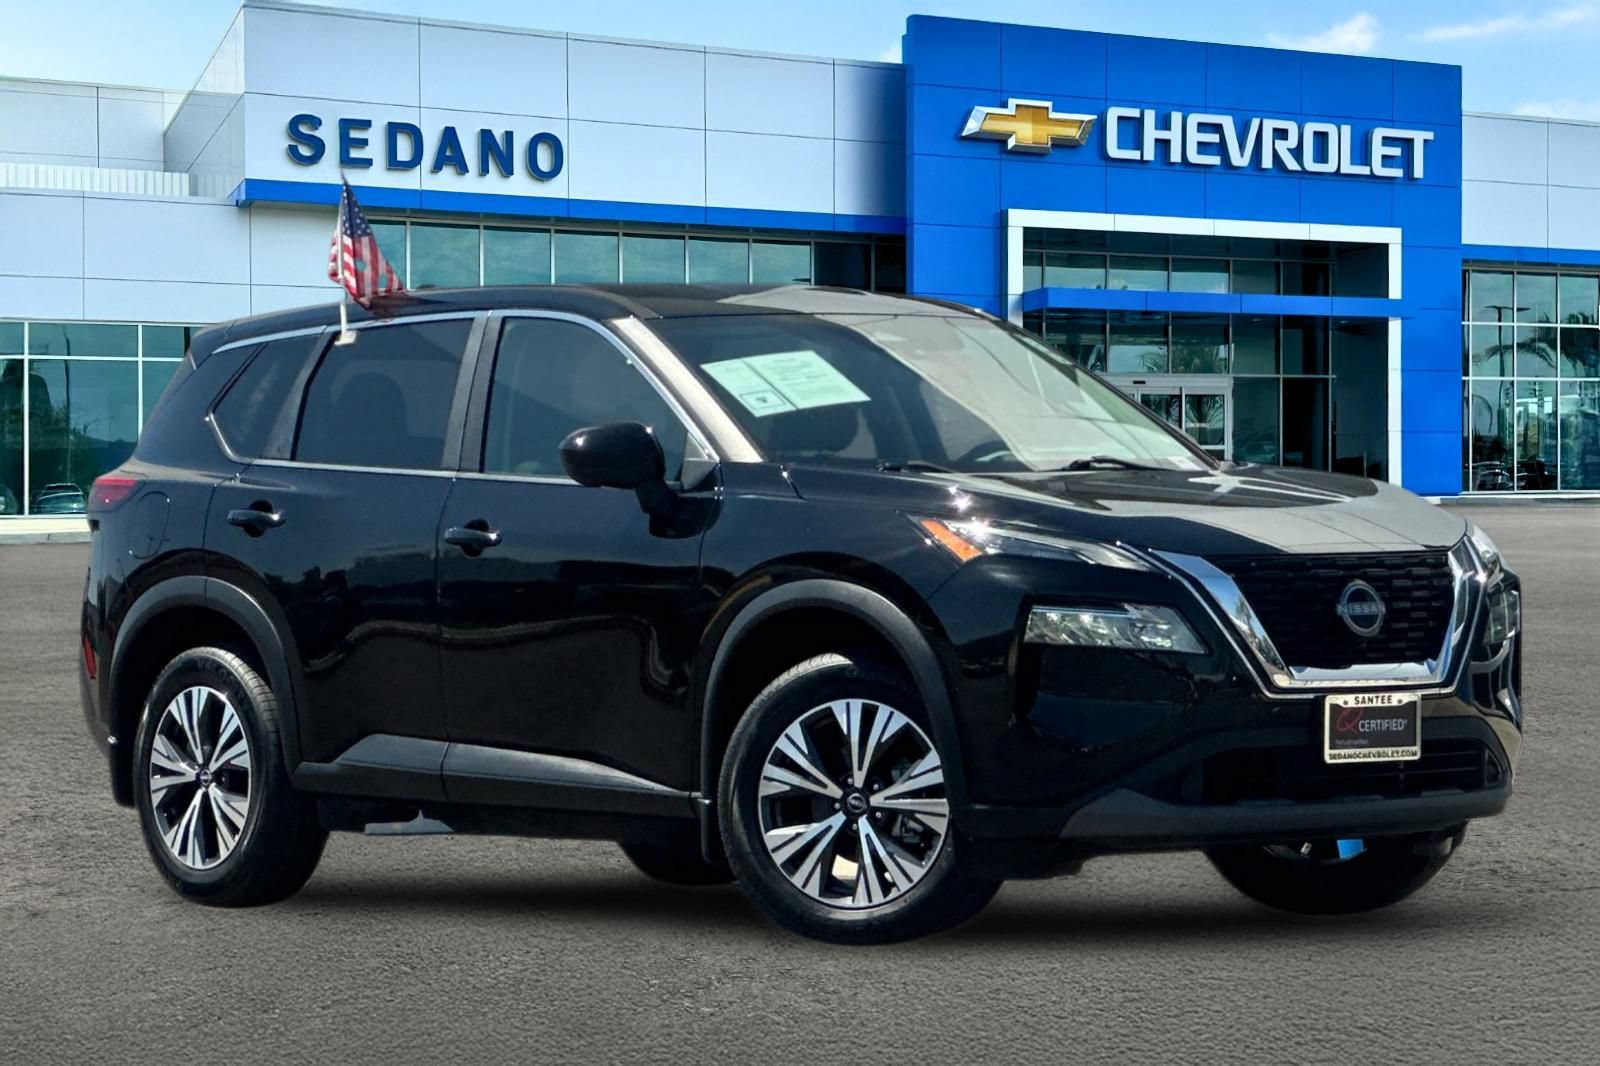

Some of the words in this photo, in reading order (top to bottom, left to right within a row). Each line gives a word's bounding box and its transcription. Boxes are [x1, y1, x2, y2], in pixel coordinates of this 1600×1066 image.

[286, 113, 564, 182] SEDANO
[1105, 106, 1435, 180] CHEVROLET
[1336, 601, 1386, 616] NISSAN
[1353, 694, 1394, 706] SANTEE
[1358, 718, 1405, 733] CERTIFIED
[1328, 750, 1418, 761] SEDANOCHEVROLET.COM
